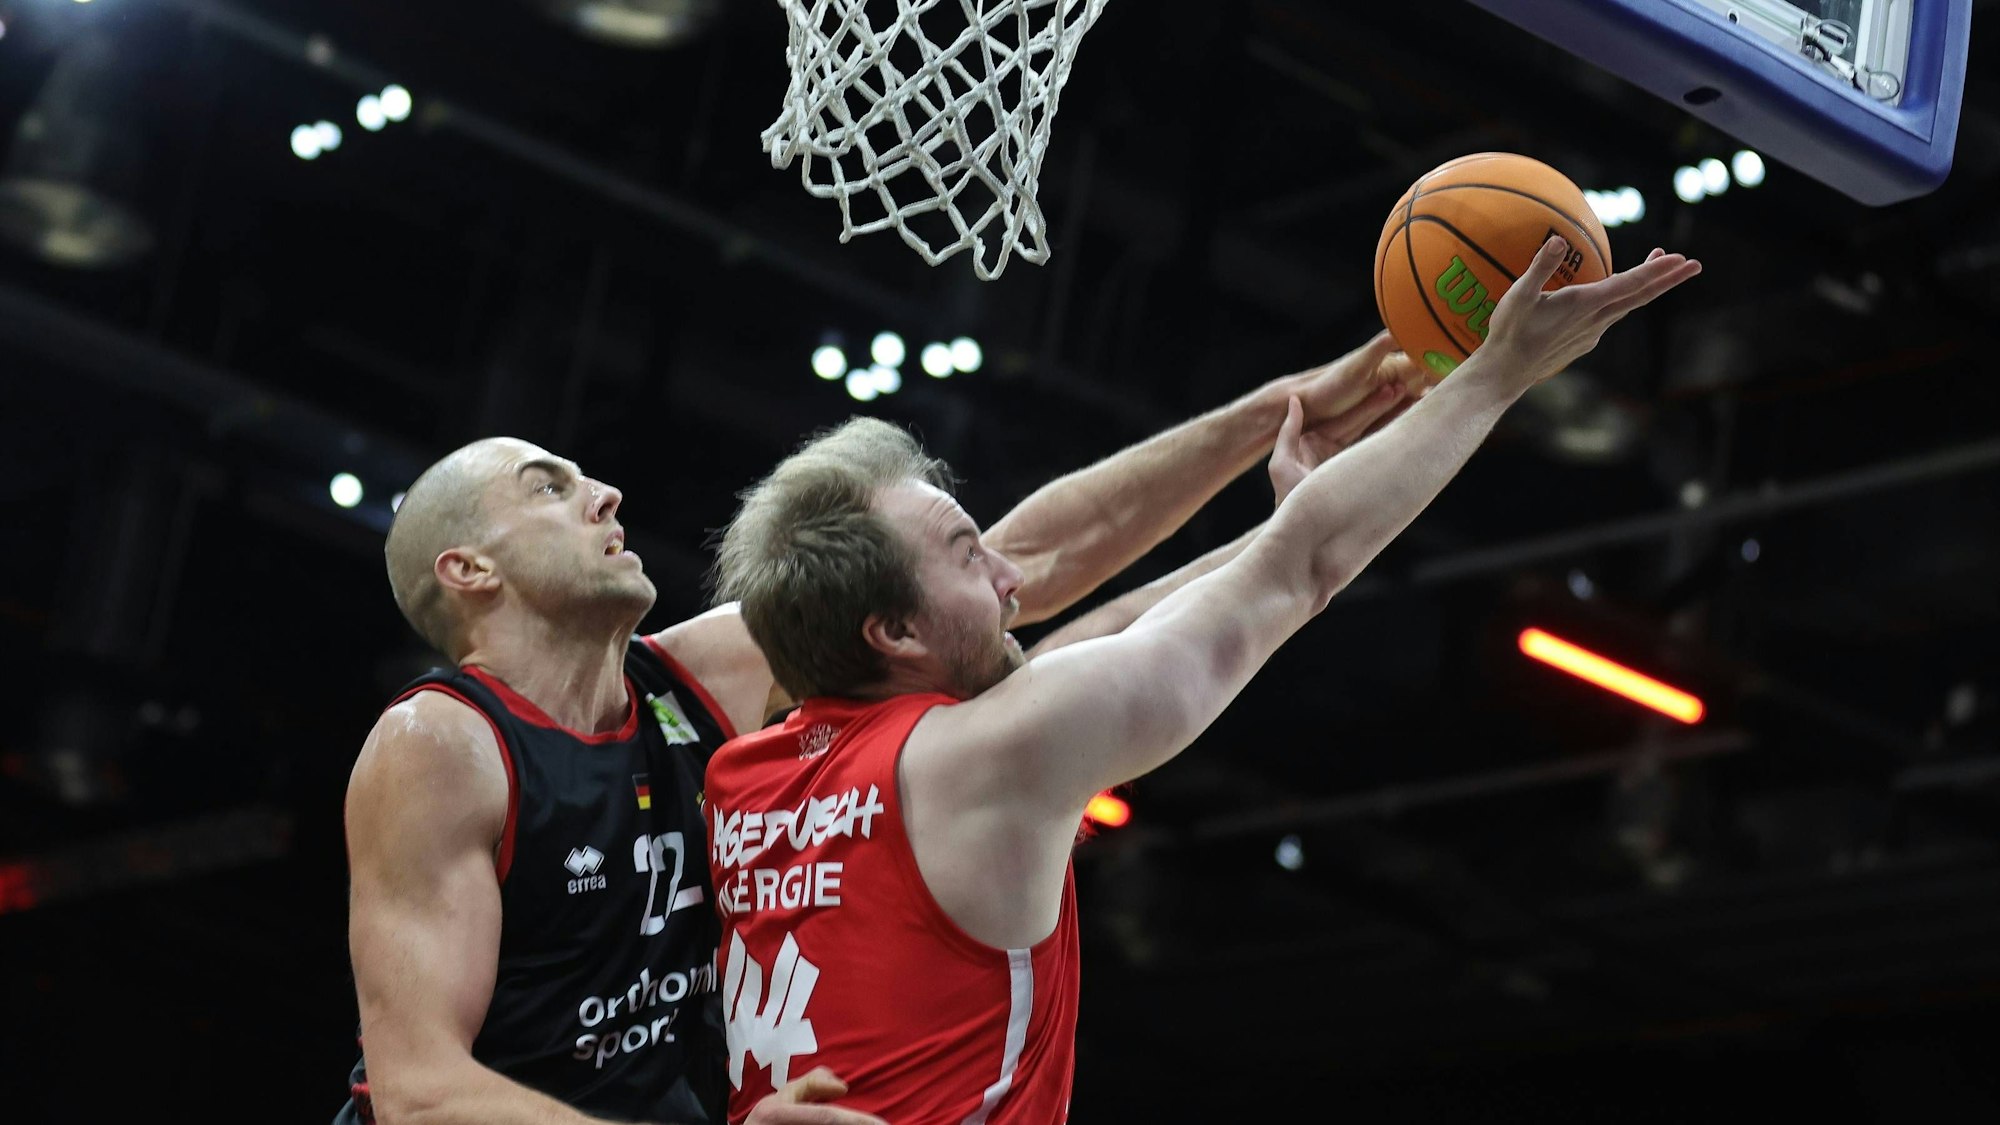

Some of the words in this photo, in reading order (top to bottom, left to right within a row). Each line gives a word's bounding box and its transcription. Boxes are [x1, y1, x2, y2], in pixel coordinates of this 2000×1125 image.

[567, 874, 607, 895] errea
[633, 831, 704, 936] 22
[723, 928, 820, 1093] 44
